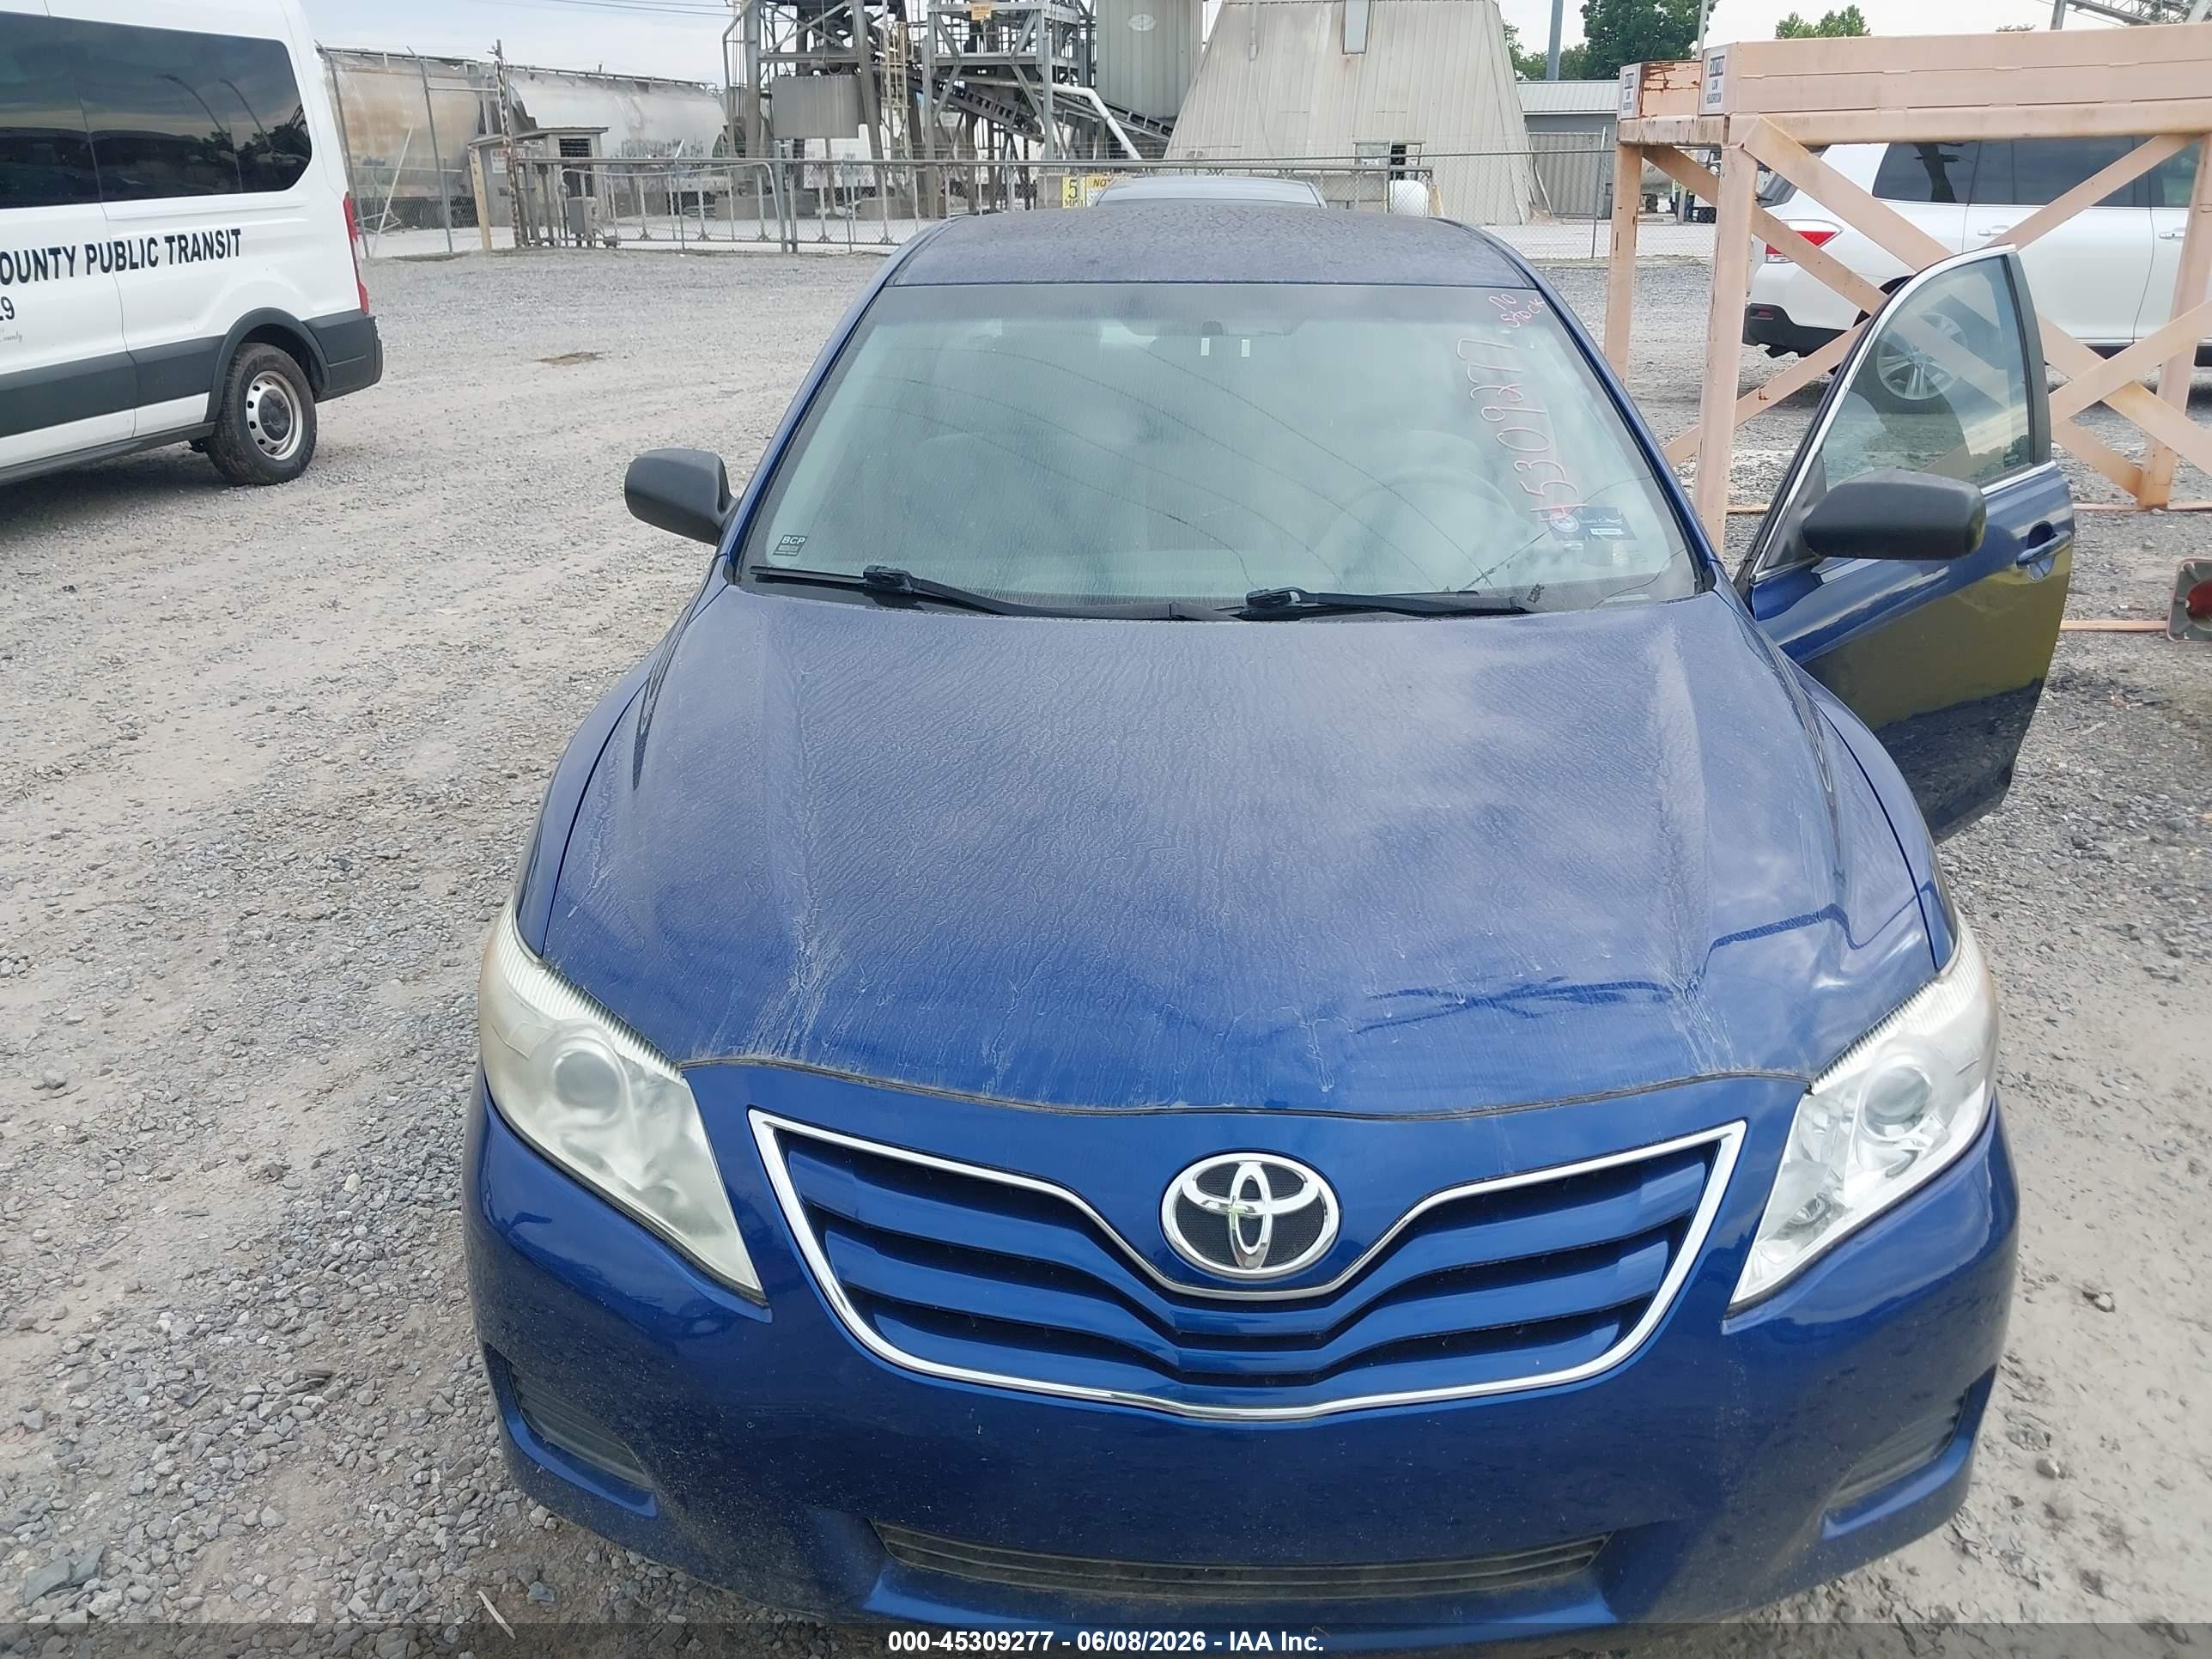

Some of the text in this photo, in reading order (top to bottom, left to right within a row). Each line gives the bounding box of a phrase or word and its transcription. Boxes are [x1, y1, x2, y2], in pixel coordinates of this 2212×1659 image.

[1068, 179, 1078, 198] 5
[84, 236, 159, 276] PUBLIC
[164, 228, 241, 265] TRANSIT
[0, 295, 15, 321] 9
[781, 536, 805, 544] BCP
